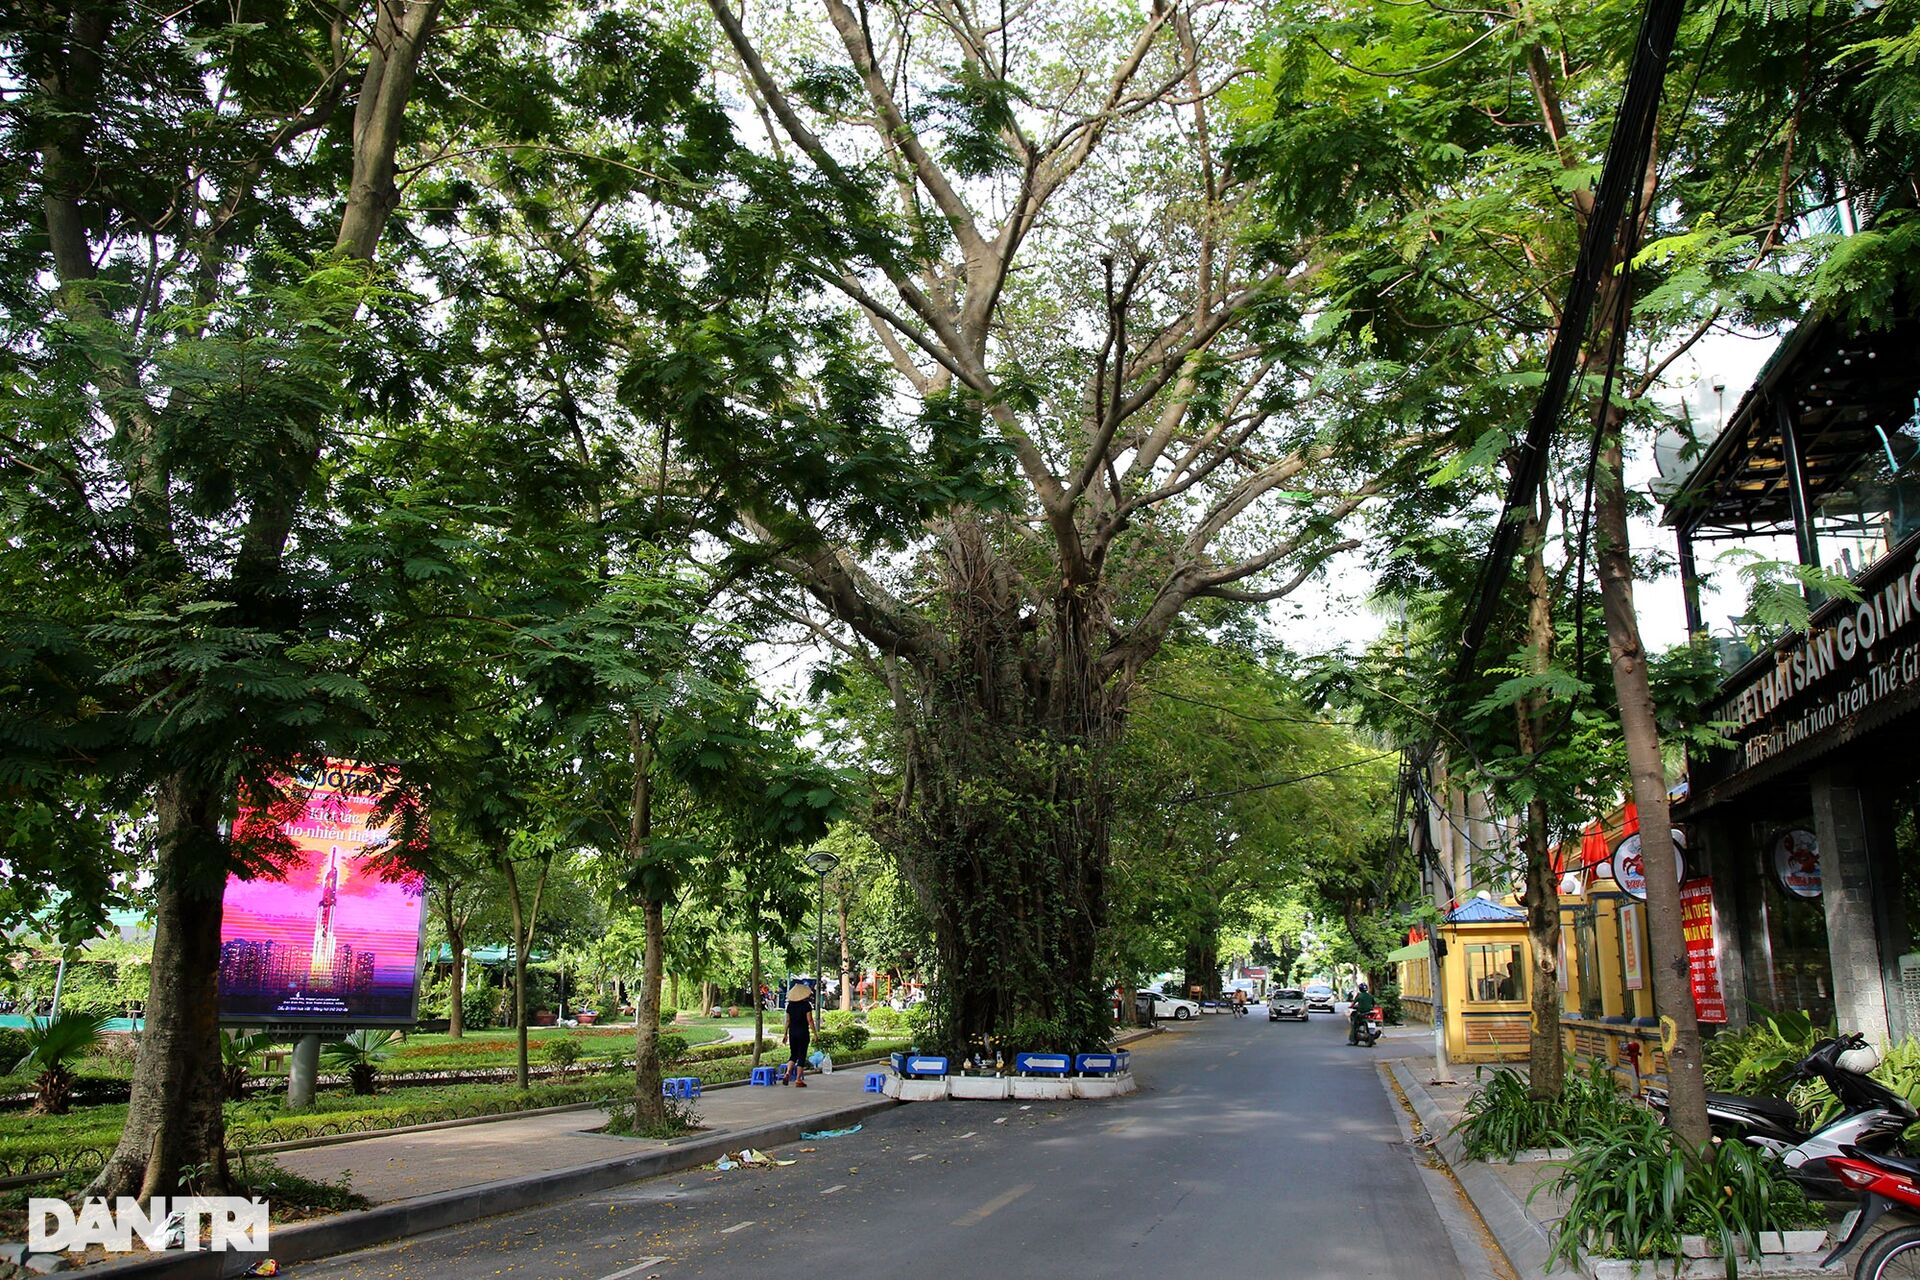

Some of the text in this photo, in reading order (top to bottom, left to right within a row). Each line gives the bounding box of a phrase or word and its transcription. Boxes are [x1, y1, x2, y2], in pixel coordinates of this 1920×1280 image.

[1761, 651, 1794, 713] HẢI
[1793, 627, 1837, 691] SẢN
[1837, 593, 1888, 664] GỌI
[1810, 697, 1835, 734] nào
[1837, 679, 1869, 719] trên
[1869, 648, 1899, 702] Thế
[317, 768, 384, 793] JOT
[282, 823, 303, 837] ho
